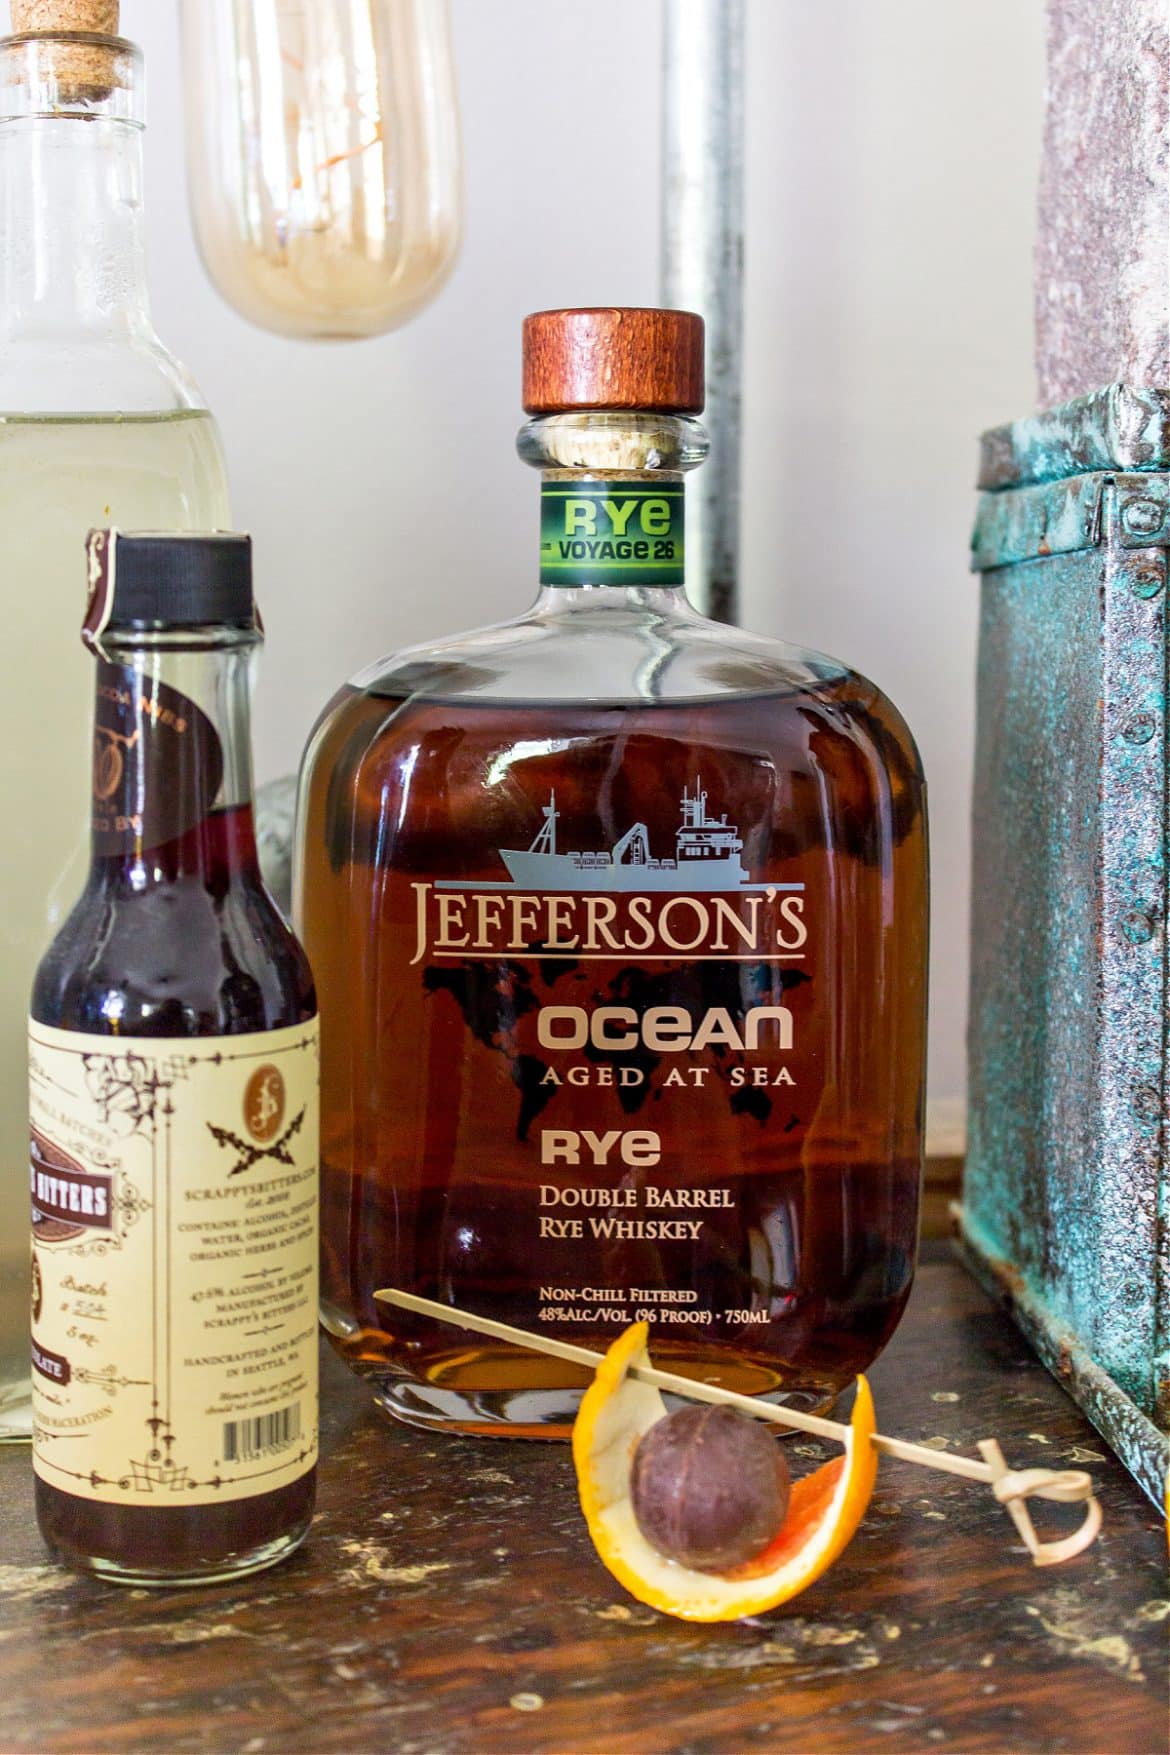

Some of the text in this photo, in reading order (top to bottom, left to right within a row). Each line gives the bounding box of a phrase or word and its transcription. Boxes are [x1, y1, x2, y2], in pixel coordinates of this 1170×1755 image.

[653, 541, 675, 560] 26
[409, 882, 808, 965] JEFFERSON'S
[538, 1066, 797, 1087] AGED AT SEA
[37, 1172, 107, 1217] BITTERS
[538, 1185, 735, 1209] DOUBLE BARREL
[538, 1216, 704, 1240] RYE WHISKEY
[189, 1248, 243, 1261] ORGANIC
[538, 1286, 698, 1304] NON-CHILL FILTERED
[660, 1308, 713, 1325] PROOF)
